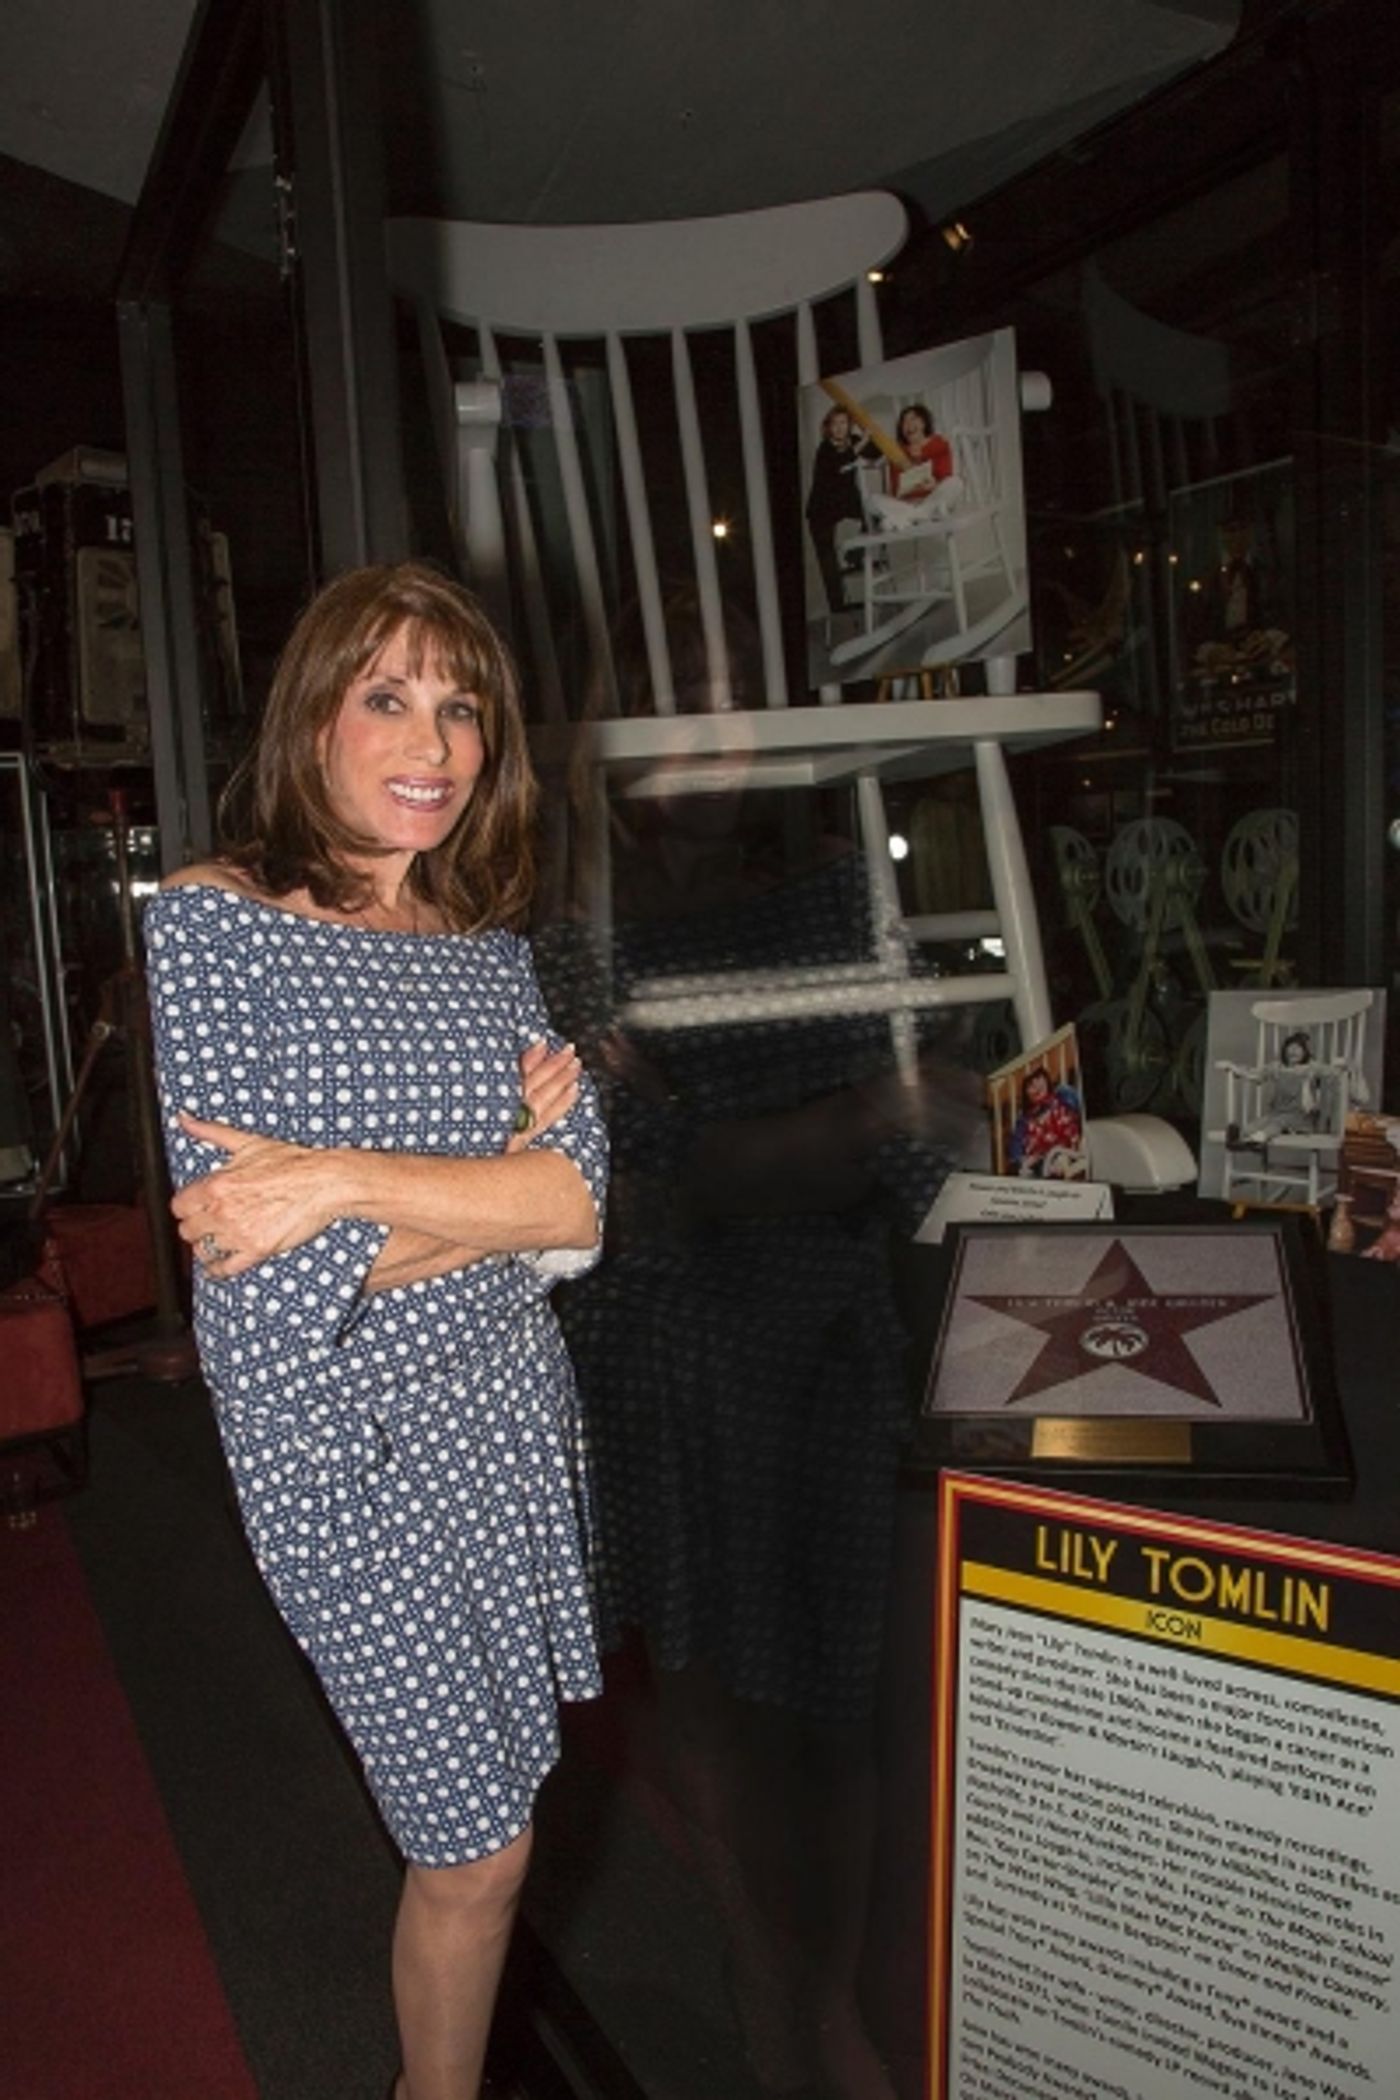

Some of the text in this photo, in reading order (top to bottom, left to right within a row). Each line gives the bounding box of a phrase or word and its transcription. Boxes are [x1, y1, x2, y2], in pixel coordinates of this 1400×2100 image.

[1036, 1525, 1329, 1632] LILY TOMLIN
[1148, 1610, 1202, 1641] ICON
